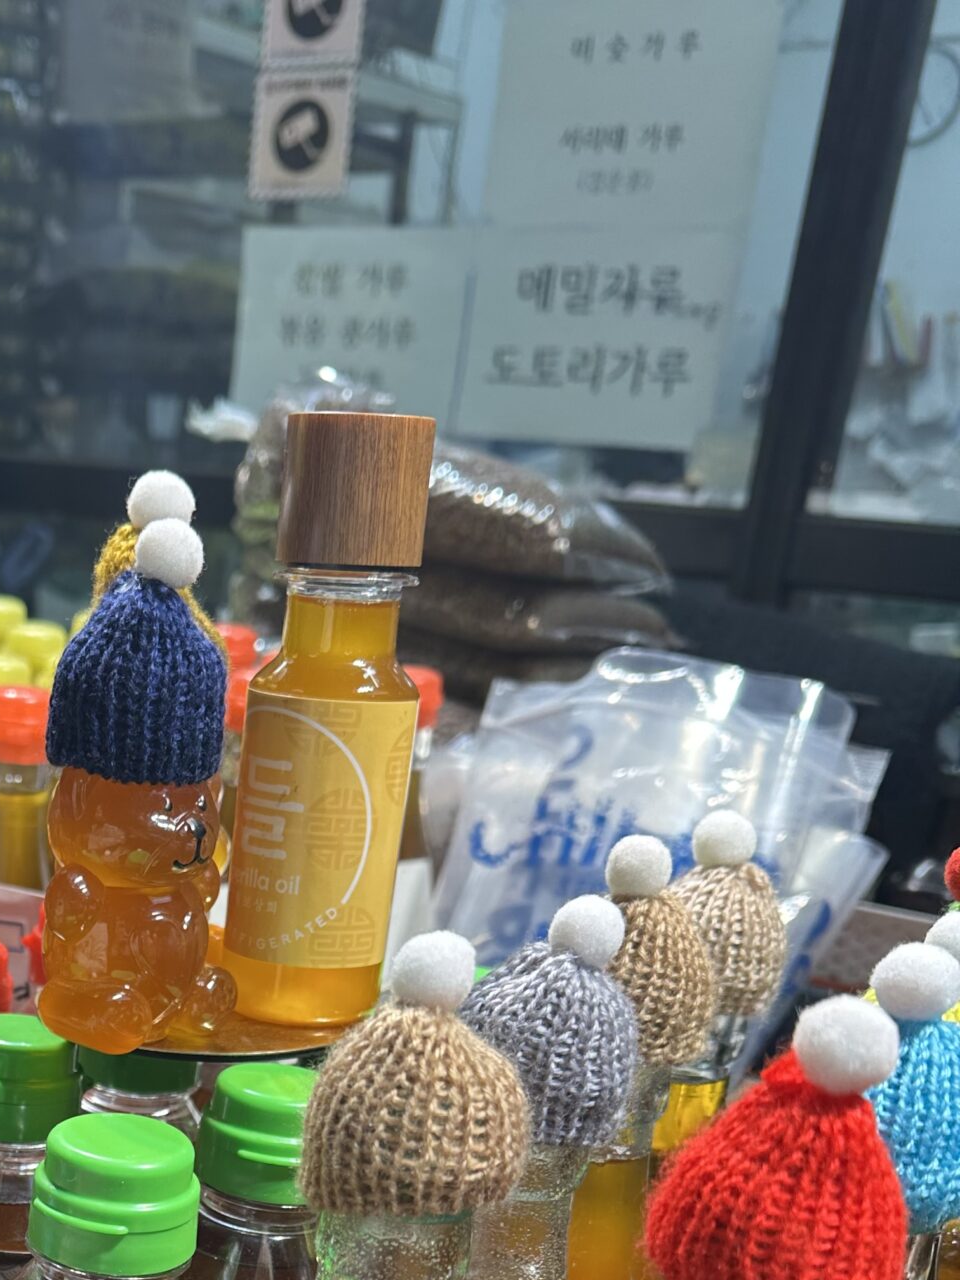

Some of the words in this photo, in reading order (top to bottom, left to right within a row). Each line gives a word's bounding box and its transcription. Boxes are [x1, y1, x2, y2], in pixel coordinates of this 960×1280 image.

[485, 342, 692, 398] 도토리가루
[275, 875, 301, 896] oil
[238, 906, 338, 952] FIGERATED
